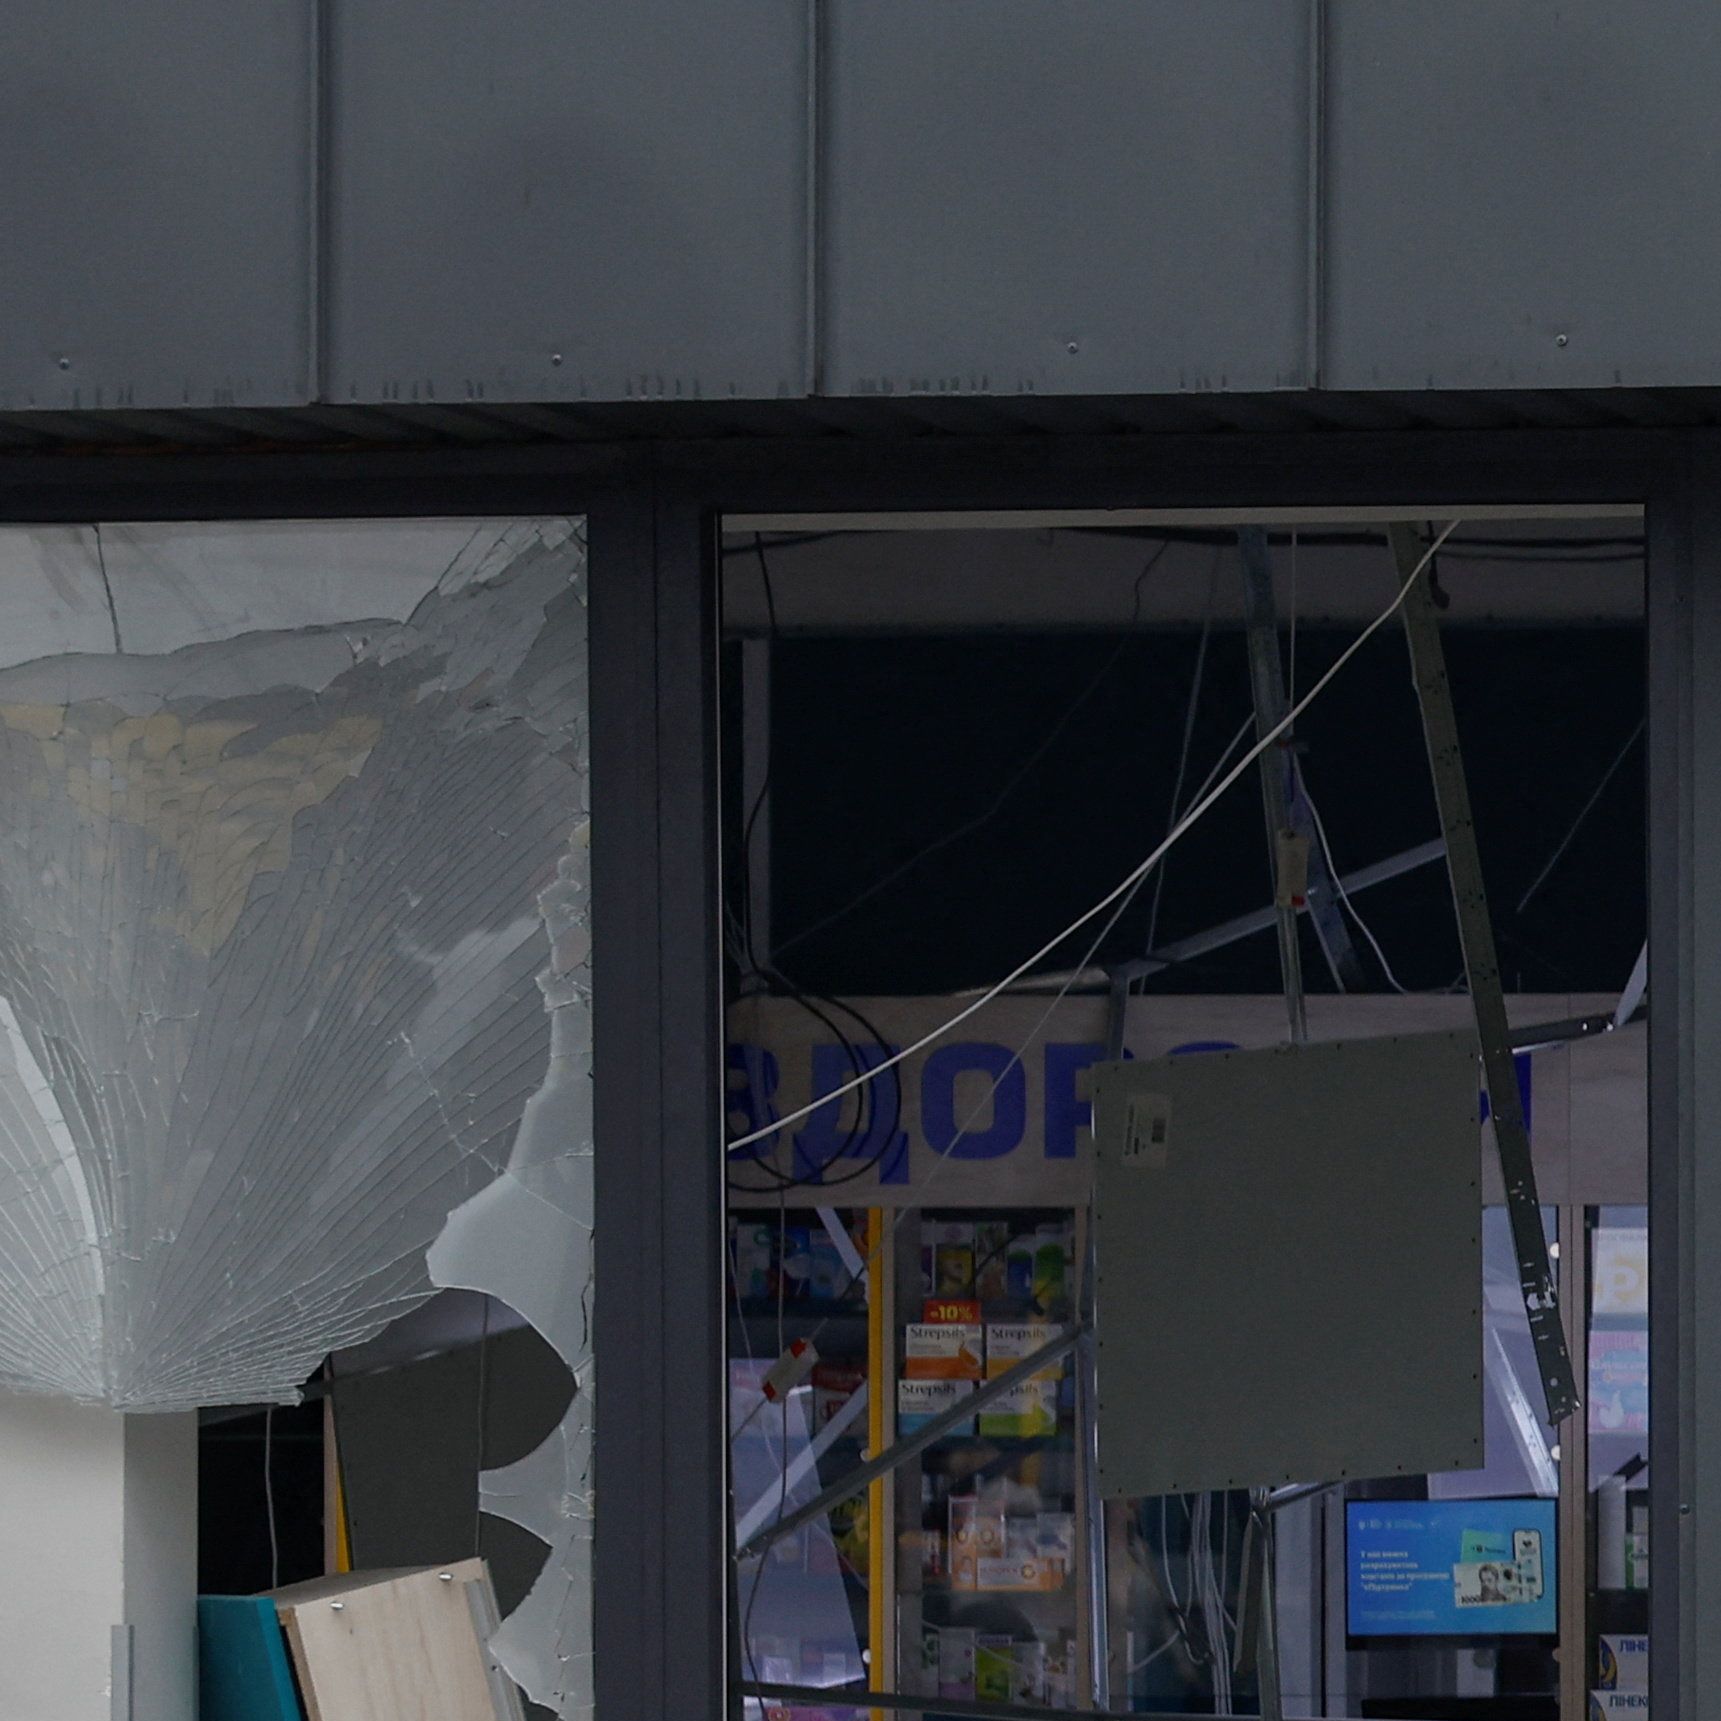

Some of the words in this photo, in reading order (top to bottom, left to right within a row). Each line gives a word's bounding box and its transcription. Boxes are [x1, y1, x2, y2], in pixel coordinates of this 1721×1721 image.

[910, 1326, 967, 1340] Strepsils
[991, 1326, 1046, 1340] Strepsils
[901, 1382, 956, 1397] Strepsils
